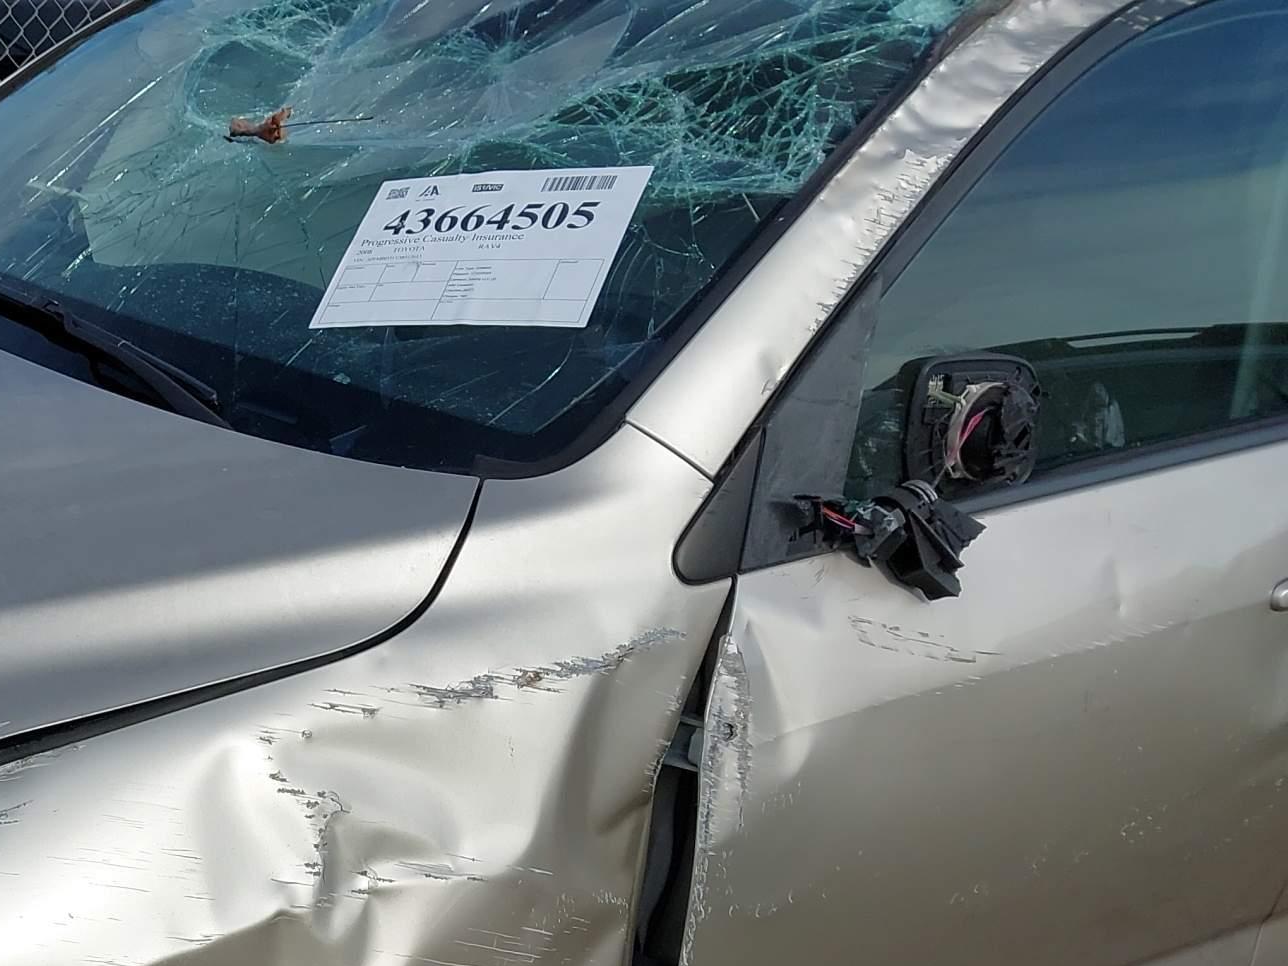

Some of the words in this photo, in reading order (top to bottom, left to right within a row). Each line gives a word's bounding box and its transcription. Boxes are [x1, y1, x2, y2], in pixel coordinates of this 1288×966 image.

[382, 201, 601, 236] 43664505
[361, 236, 421, 248] Progressive
[422, 233, 468, 244] Casualty
[471, 232, 524, 242] Insurance
